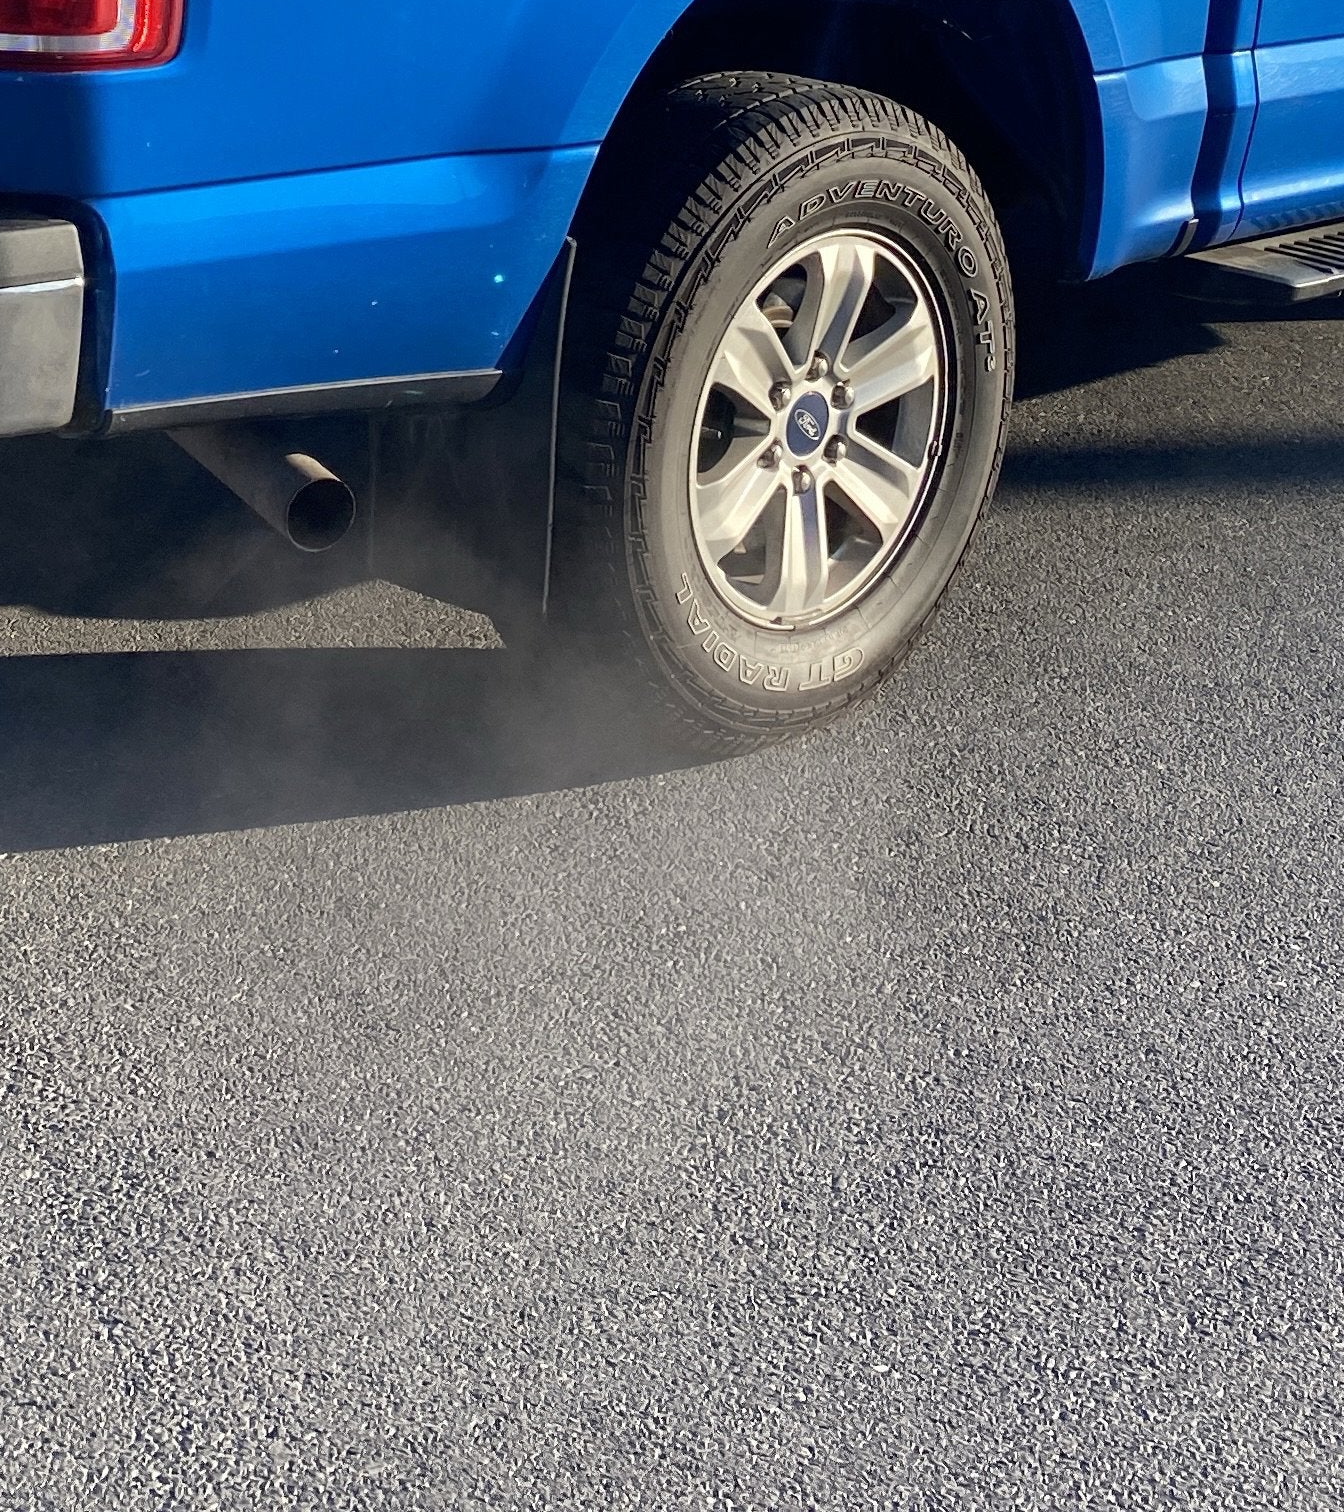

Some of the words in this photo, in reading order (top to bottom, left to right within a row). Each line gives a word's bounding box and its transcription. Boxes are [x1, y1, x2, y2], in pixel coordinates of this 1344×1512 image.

[767, 180, 978, 278] ADVENTURO
[675, 572, 791, 692] RADIAL
[799, 646, 865, 691] GT
